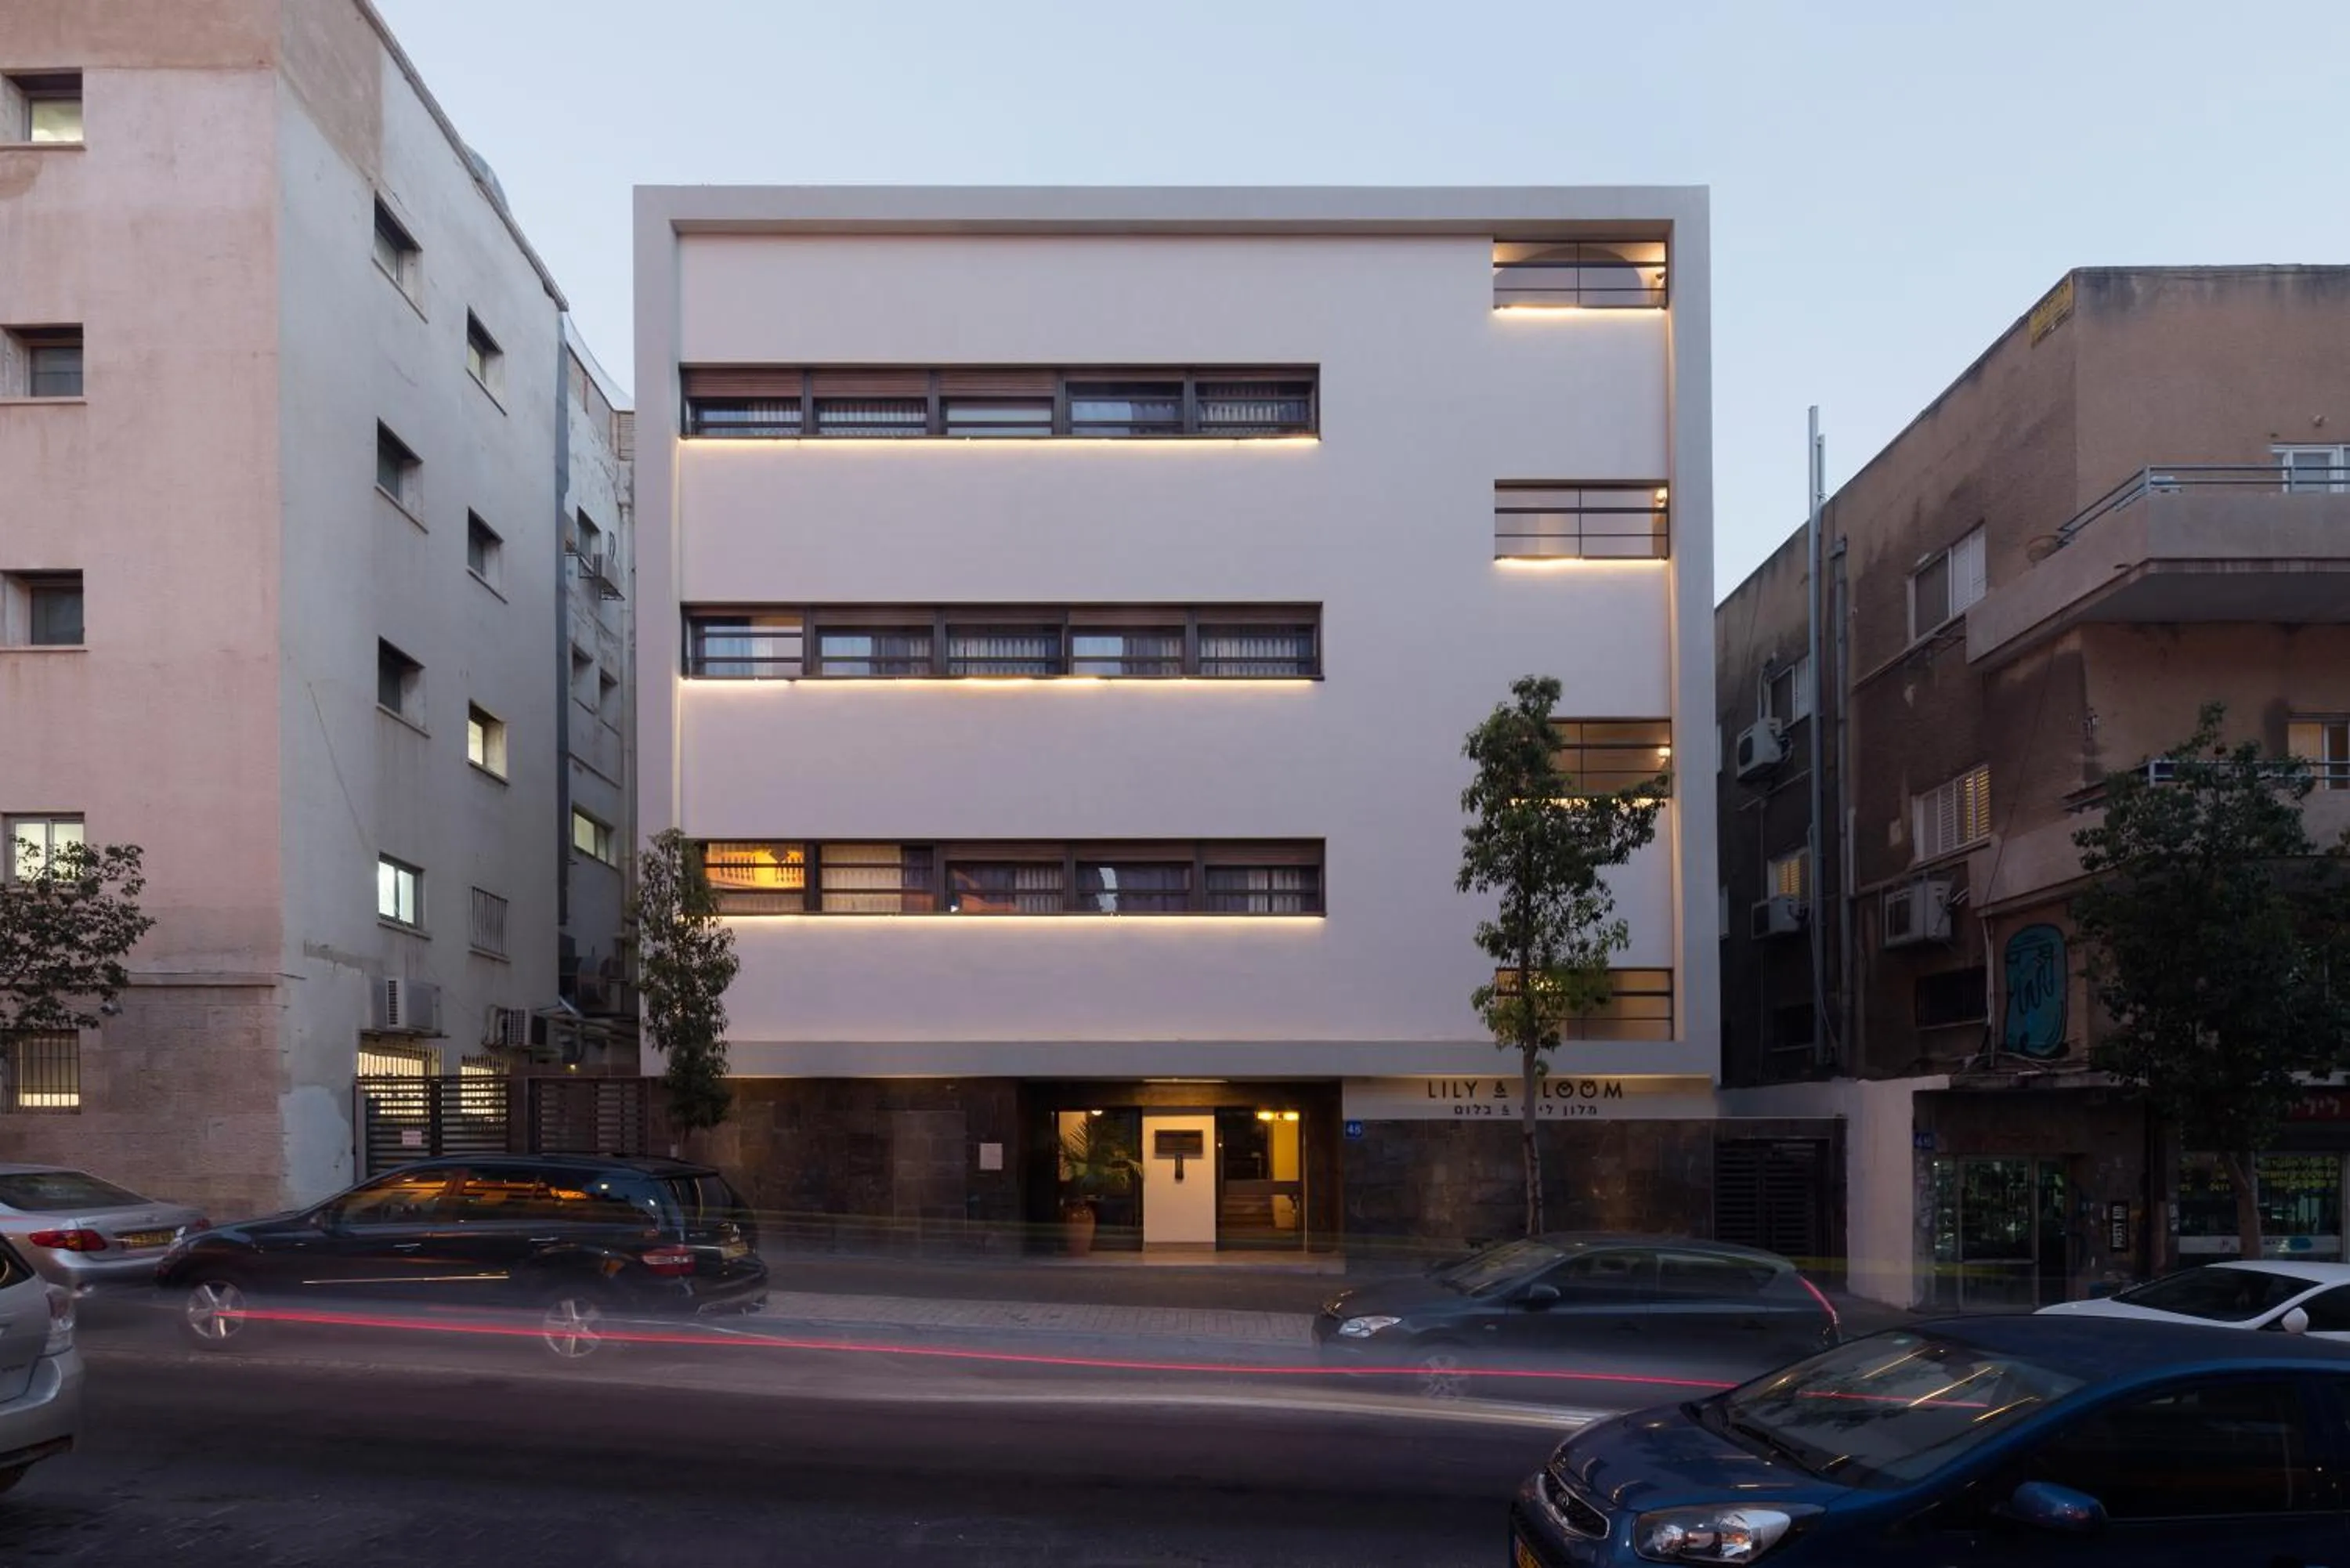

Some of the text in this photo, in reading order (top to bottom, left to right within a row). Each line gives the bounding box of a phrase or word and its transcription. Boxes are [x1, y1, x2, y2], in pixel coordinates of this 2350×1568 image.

[1428, 1080, 1622, 1098] LILY & LOOM
[1520, 1104, 1553, 1115] ליי
[1563, 1104, 1597, 1116] מלון
